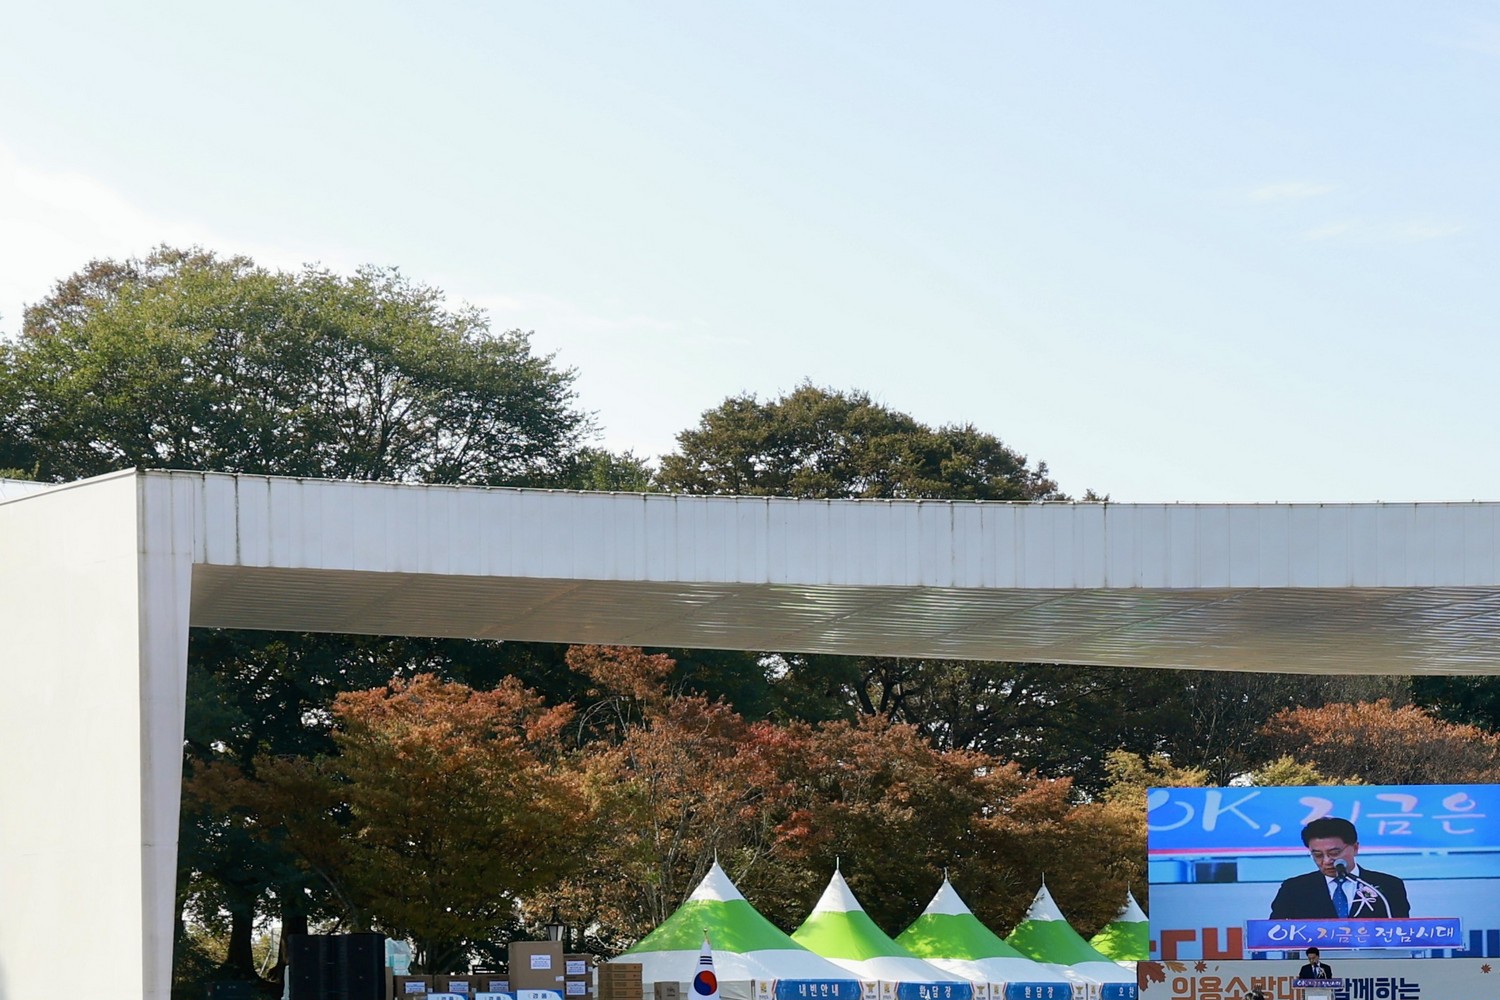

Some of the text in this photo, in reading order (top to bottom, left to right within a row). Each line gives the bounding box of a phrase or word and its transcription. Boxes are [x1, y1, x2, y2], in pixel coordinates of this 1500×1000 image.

[1148, 789, 1281, 837] OK,
[1268, 924, 1313, 943] OK,
[1317, 927, 1370, 943] 지금은
[1375, 925, 1454, 943] 전남시대
[799, 984, 839, 997] 내빈안내
